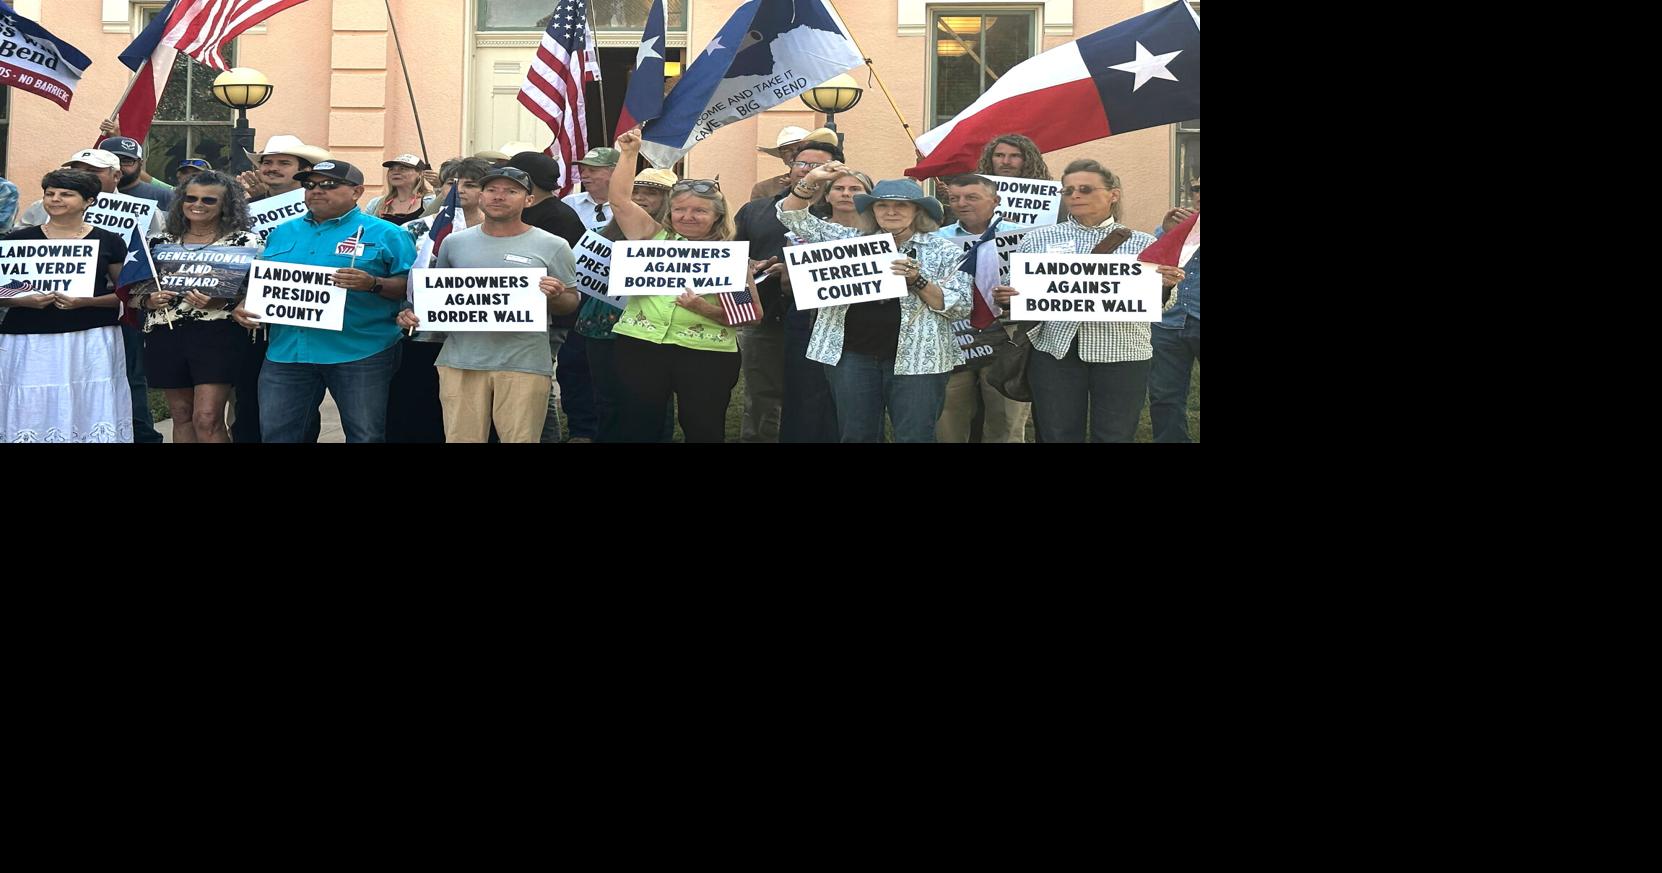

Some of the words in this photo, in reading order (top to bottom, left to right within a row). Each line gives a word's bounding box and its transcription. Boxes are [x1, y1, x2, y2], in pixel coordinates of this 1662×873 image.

[0, 39, 59, 71] Bend
[18, 73, 34, 85] NO
[727, 89, 753, 106] AND
[754, 75, 783, 93] TAKE
[784, 69, 793, 79] IT
[695, 119, 721, 142] SAVE
[736, 100, 760, 116] BIG
[773, 77, 807, 99] BEND
[1007, 197, 1052, 211] VERDE
[0, 245, 94, 258] LANDOWNER
[156, 251, 248, 264] GENERATIONAL
[626, 247, 731, 259] LANDOWNERS
[789, 240, 892, 266] LANDOWNER
[1, 262, 29, 275] VAL
[36, 262, 87, 275] VERDE
[178, 263, 213, 274] LAND
[643, 262, 711, 274] AGAINST
[808, 261, 883, 282] TERRELL
[1024, 262, 1142, 276] LANDOWNERS
[160, 275, 220, 287] STEWARD
[254, 266, 337, 287] LANDOWNE
[425, 276, 529, 289] LANDOWNERS
[624, 276, 687, 288] BORDER
[693, 276, 733, 288] WALL
[817, 280, 882, 301] COUNTY
[1046, 281, 1121, 294] AGAINST
[262, 285, 331, 304] PRESIDIO
[444, 293, 511, 306] AGAINST
[1026, 298, 1095, 312] BORDER
[1102, 299, 1147, 313] WALL
[265, 304, 324, 322] COUNTY
[427, 310, 489, 323] BORDER
[494, 310, 534, 323] WALL
